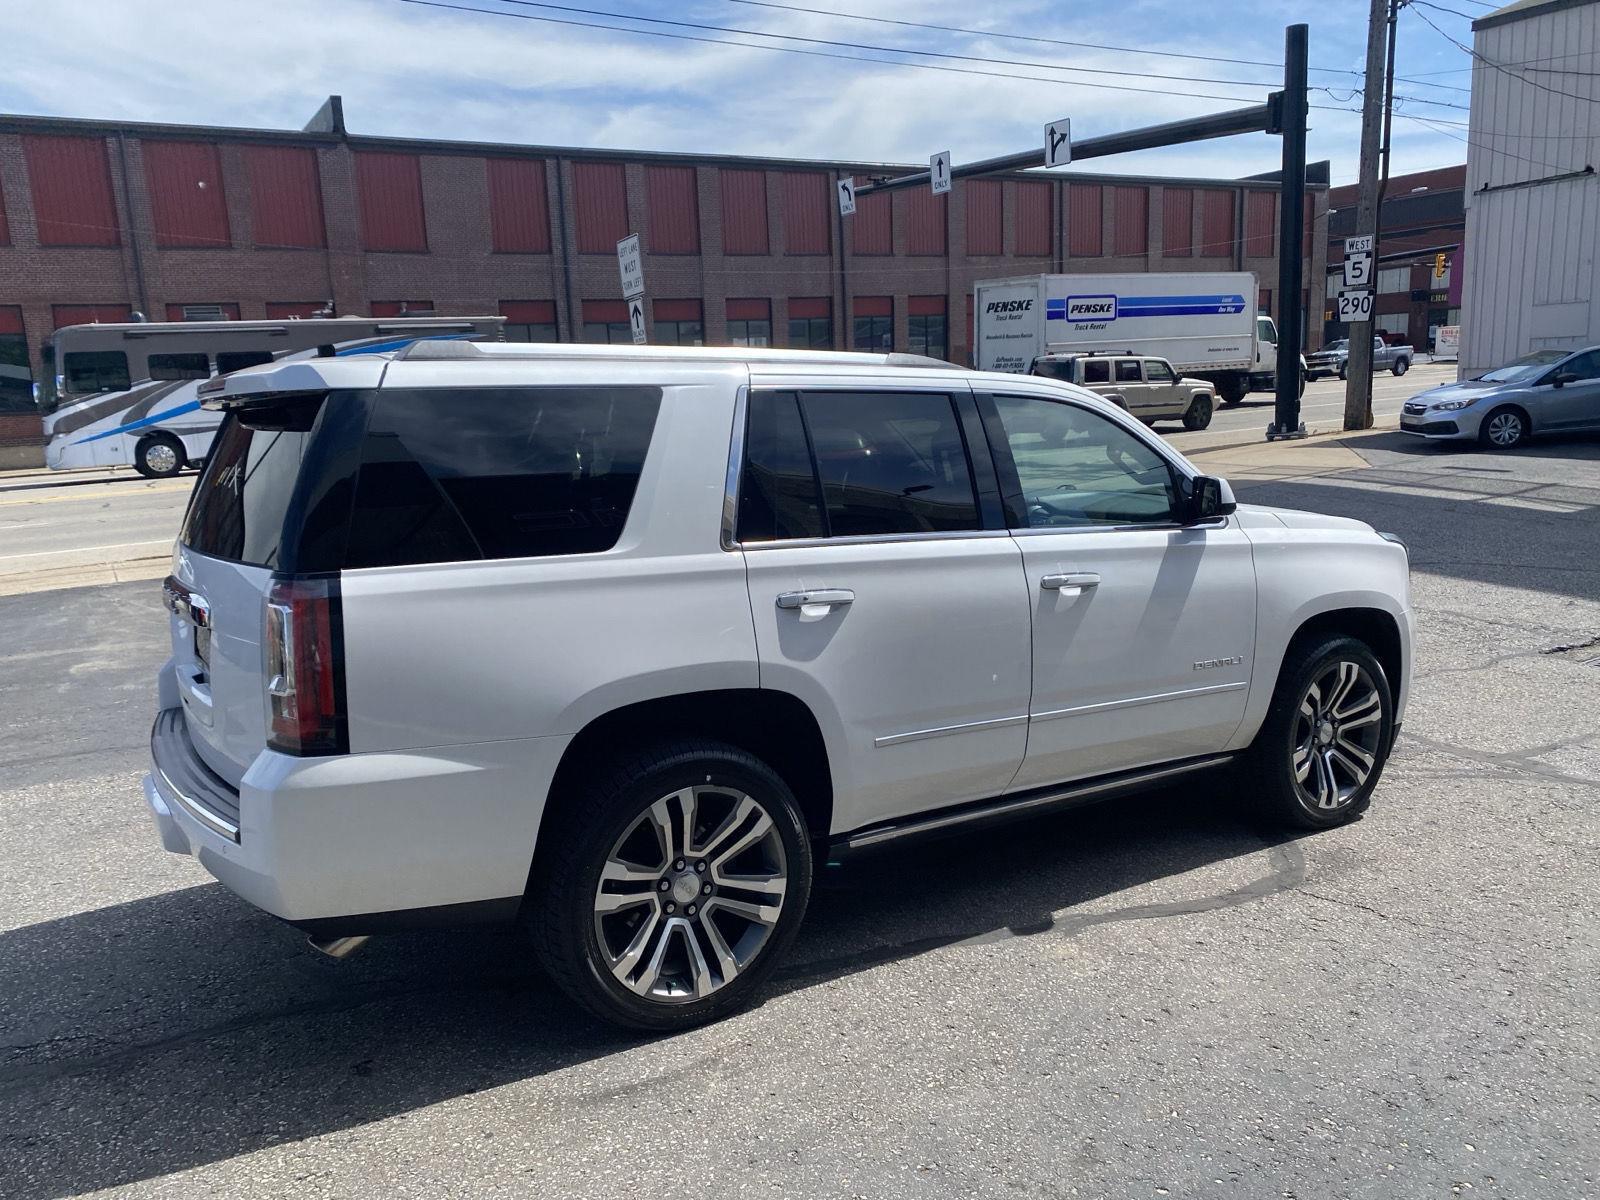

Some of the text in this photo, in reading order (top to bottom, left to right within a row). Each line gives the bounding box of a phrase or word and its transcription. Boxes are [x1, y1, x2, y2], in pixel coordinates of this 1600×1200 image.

[934, 180, 948, 190] ONLY
[842, 203, 854, 212] ONLY
[628, 242, 638, 255] LANE
[1348, 239, 1370, 250] WEST
[624, 259, 637, 274] MUST
[1351, 260, 1364, 279] 5
[986, 299, 1034, 314] PENSKE
[1070, 303, 1114, 314] PENSKE
[1340, 296, 1371, 315] 290
[1074, 322, 1107, 331] Truck Rental
[1192, 655, 1244, 671] DENALI
